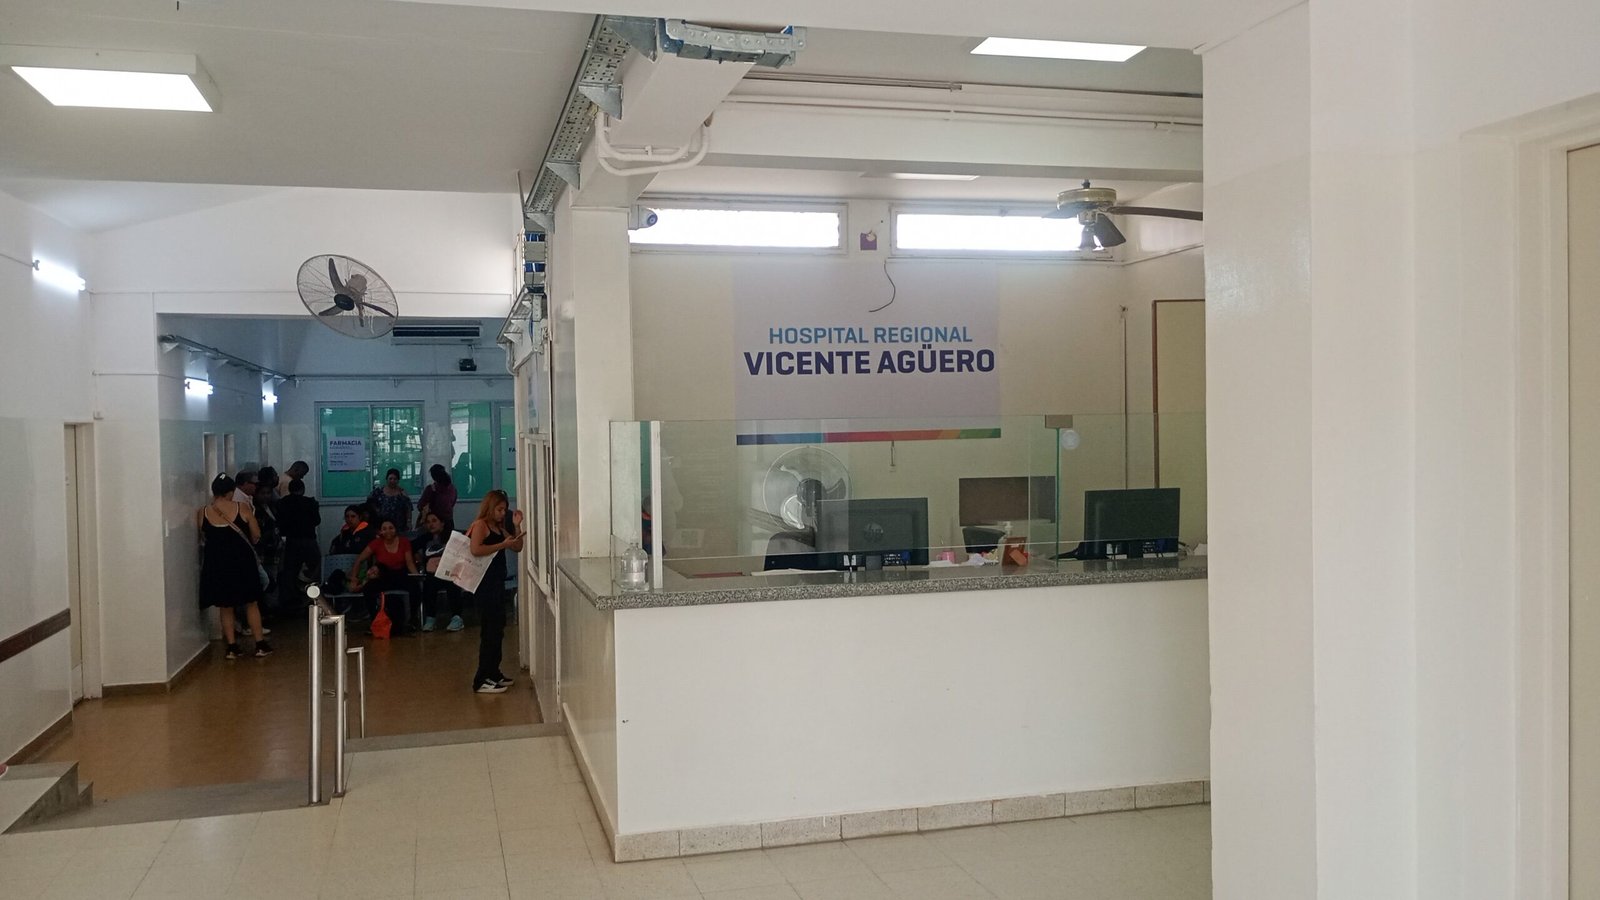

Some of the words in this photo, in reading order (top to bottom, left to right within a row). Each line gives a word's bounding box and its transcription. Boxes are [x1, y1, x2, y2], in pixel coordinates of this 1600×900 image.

[769, 327, 869, 344] HOSPITAL
[873, 326, 973, 343] REGIONAL
[743, 351, 871, 375] VICENTE
[876, 344, 995, 374] AGÜERO
